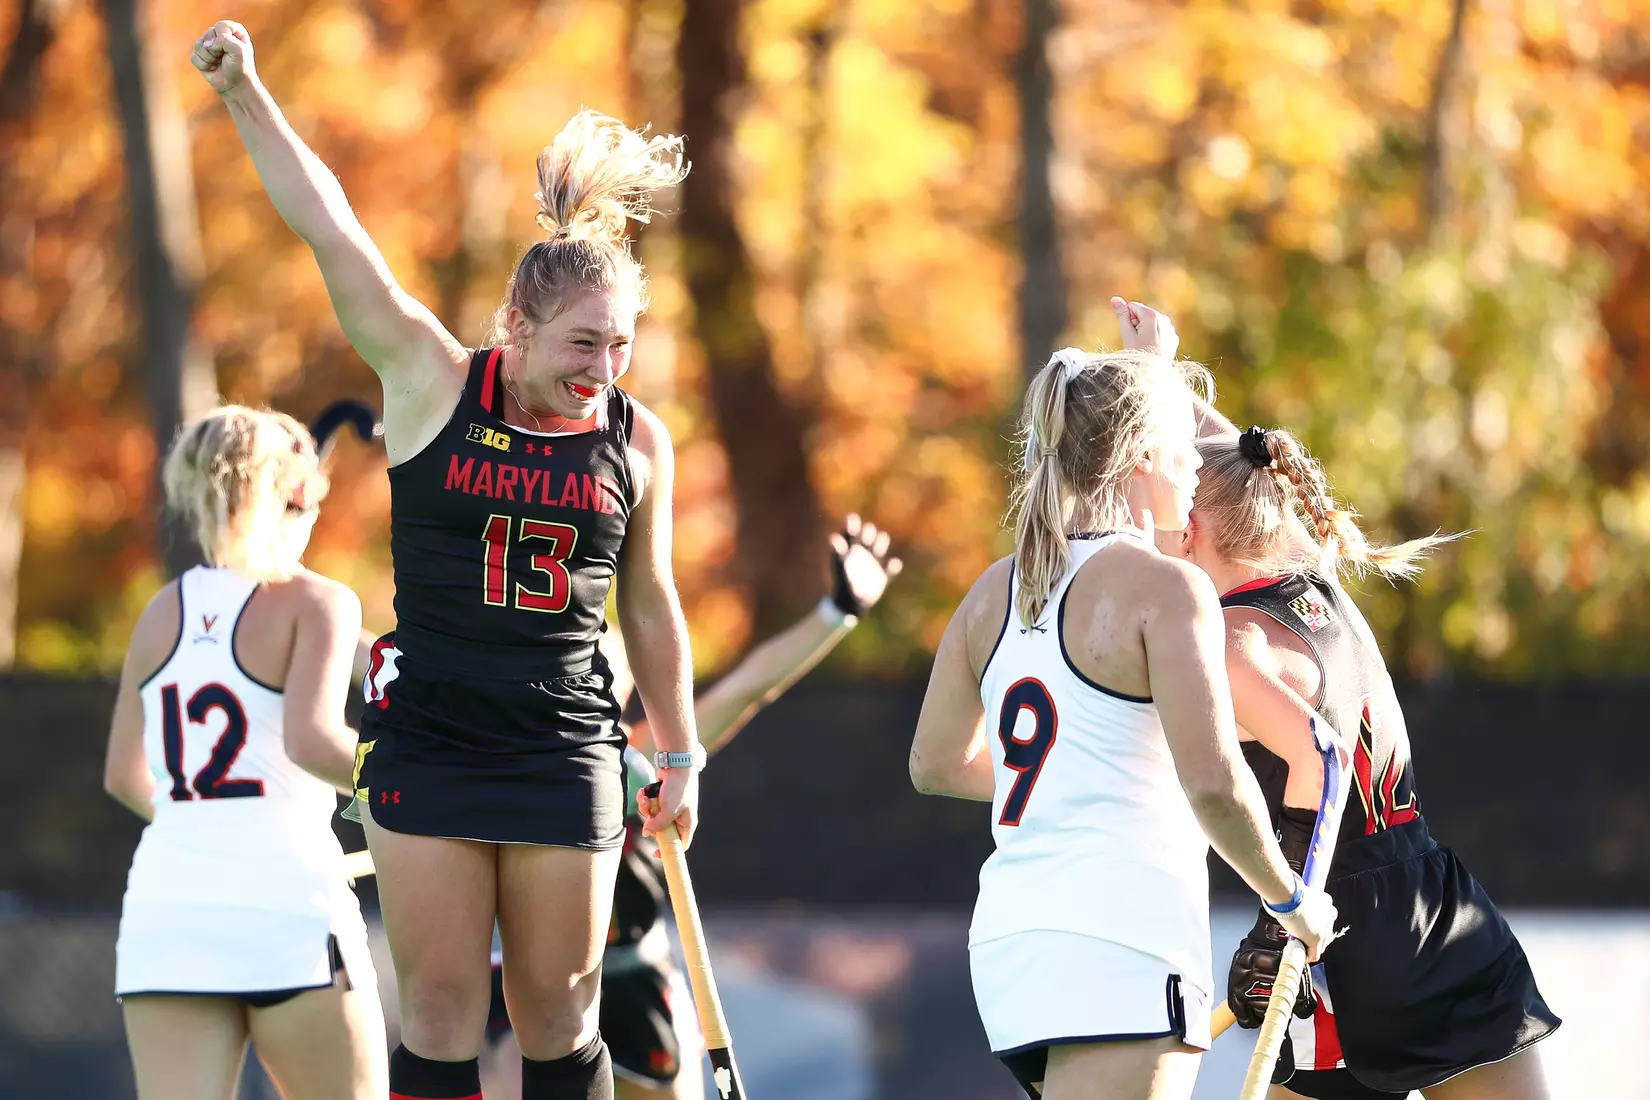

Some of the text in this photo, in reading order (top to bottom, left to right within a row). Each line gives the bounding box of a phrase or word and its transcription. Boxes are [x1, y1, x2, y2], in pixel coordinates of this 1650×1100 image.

[444, 454, 617, 515] MARYLAND
[482, 514, 578, 613] 13
[161, 682, 265, 801] 12
[999, 677, 1058, 826] 9
